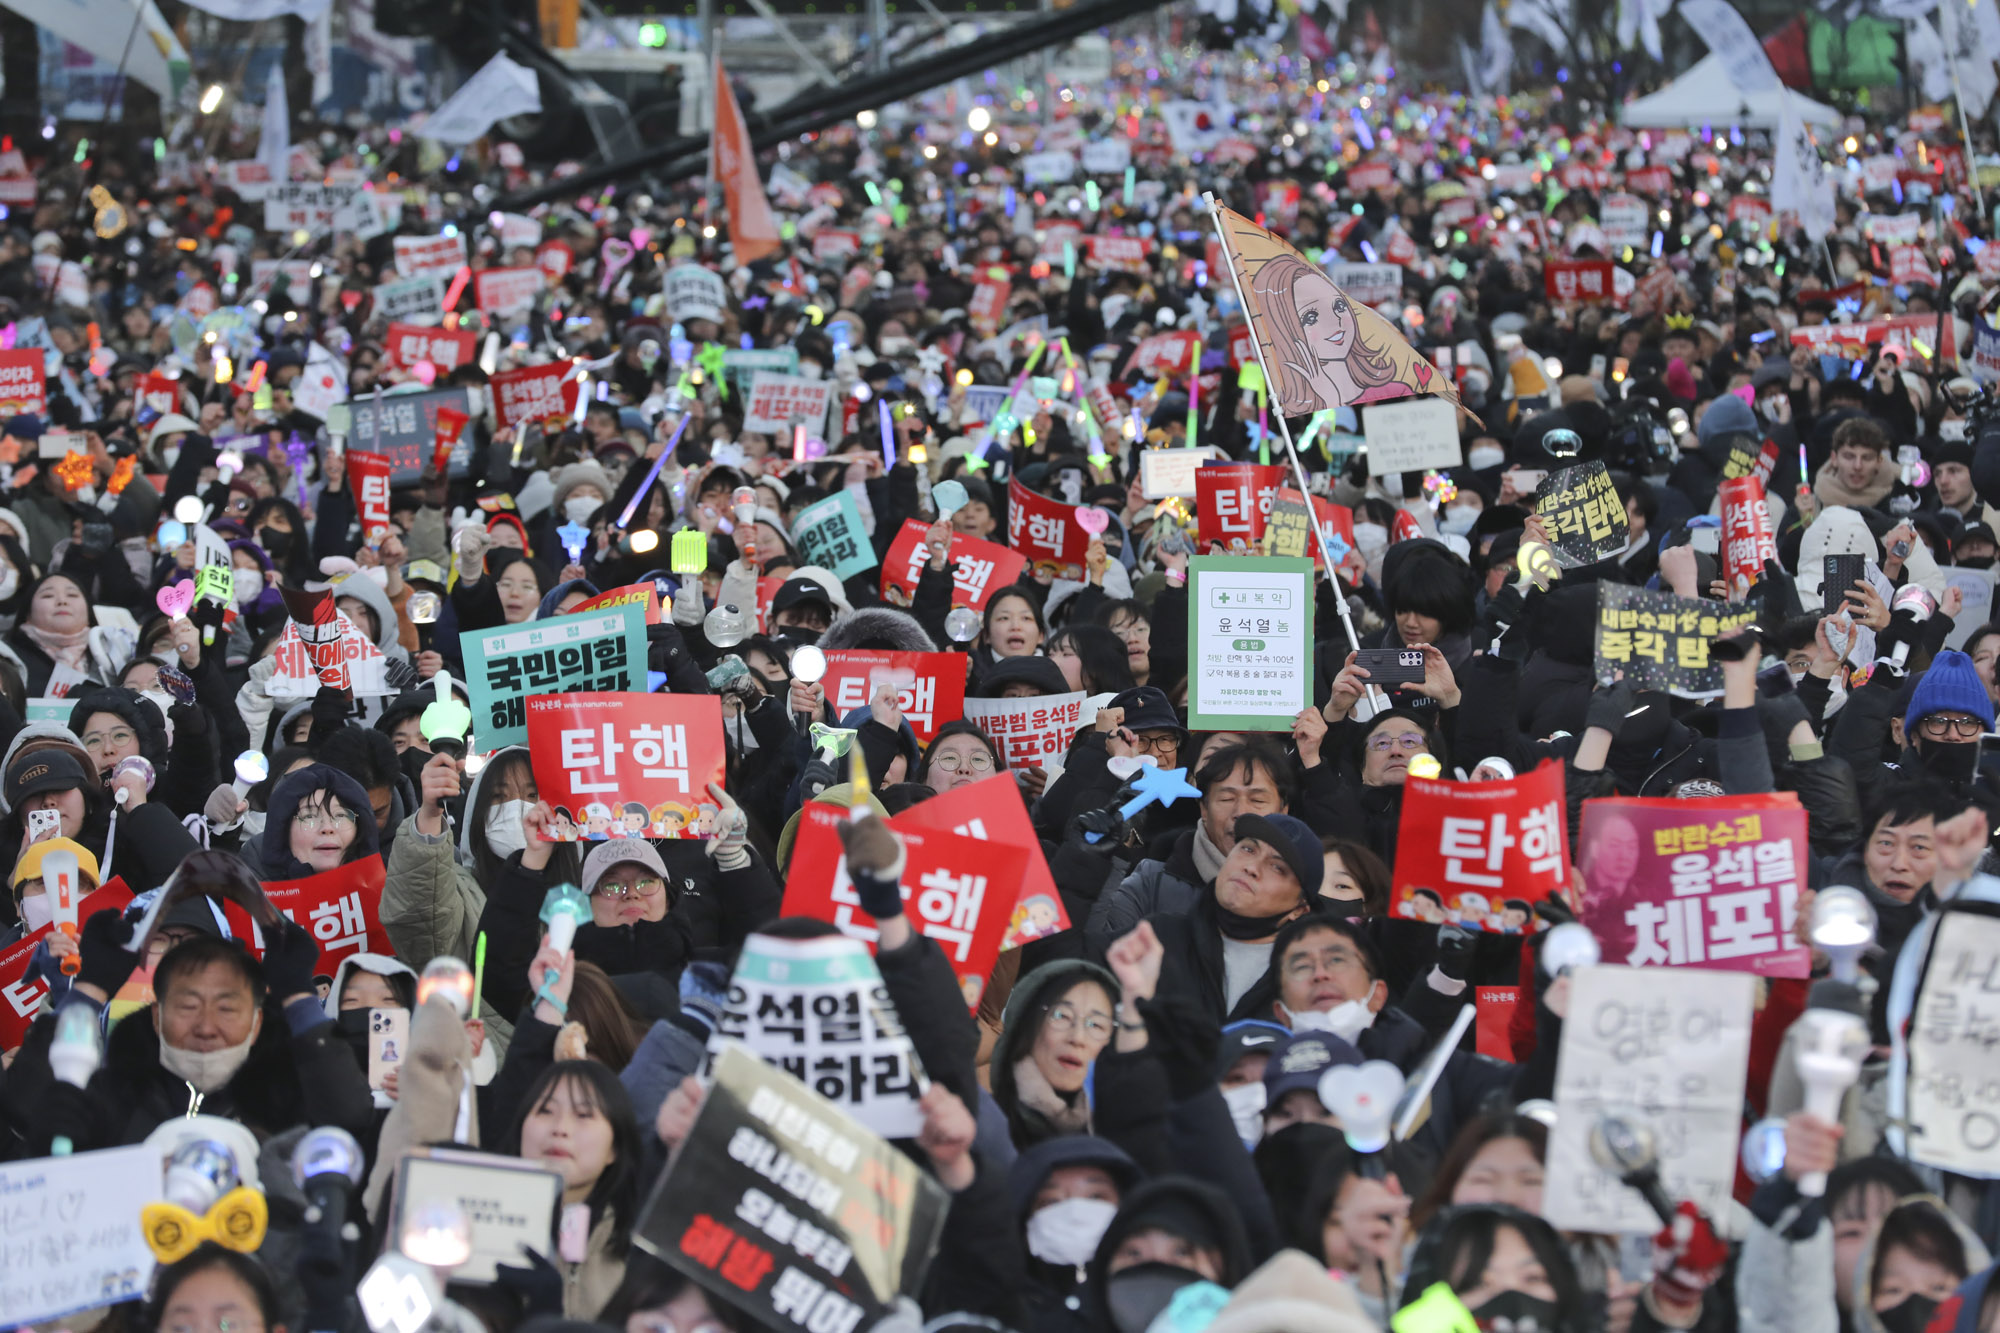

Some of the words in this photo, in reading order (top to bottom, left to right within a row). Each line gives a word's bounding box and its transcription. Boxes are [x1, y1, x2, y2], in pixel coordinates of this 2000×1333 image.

[1536, 483, 1588, 515] 내란수괴
[1541, 506, 1585, 543] 즉각
[1583, 486, 1629, 542] 탄핵
[1219, 618, 1270, 633] 윤석열
[1602, 608, 1676, 633] 내란수괴
[486, 634, 628, 692] 국민의힘
[1273, 655, 1294, 664] 100년
[1601, 631, 1667, 664] 즉각
[531, 699, 562, 712] 나눔문화
[563, 701, 623, 709] www.nanum.com
[1031, 701, 1080, 730] 윤석열
[19, 765, 49, 785] emis
[561, 722, 690, 795] 탄핵
[1440, 800, 1564, 888] 탄핵
[1654, 814, 1763, 856] 반란수괴
[1670, 838, 1797, 897] 윤석열
[1625, 881, 1802, 969] 체포!
[727, 1126, 842, 1216] 하나되어
[679, 1213, 774, 1297] 해방
[735, 1187, 852, 1277] 오늘부터
